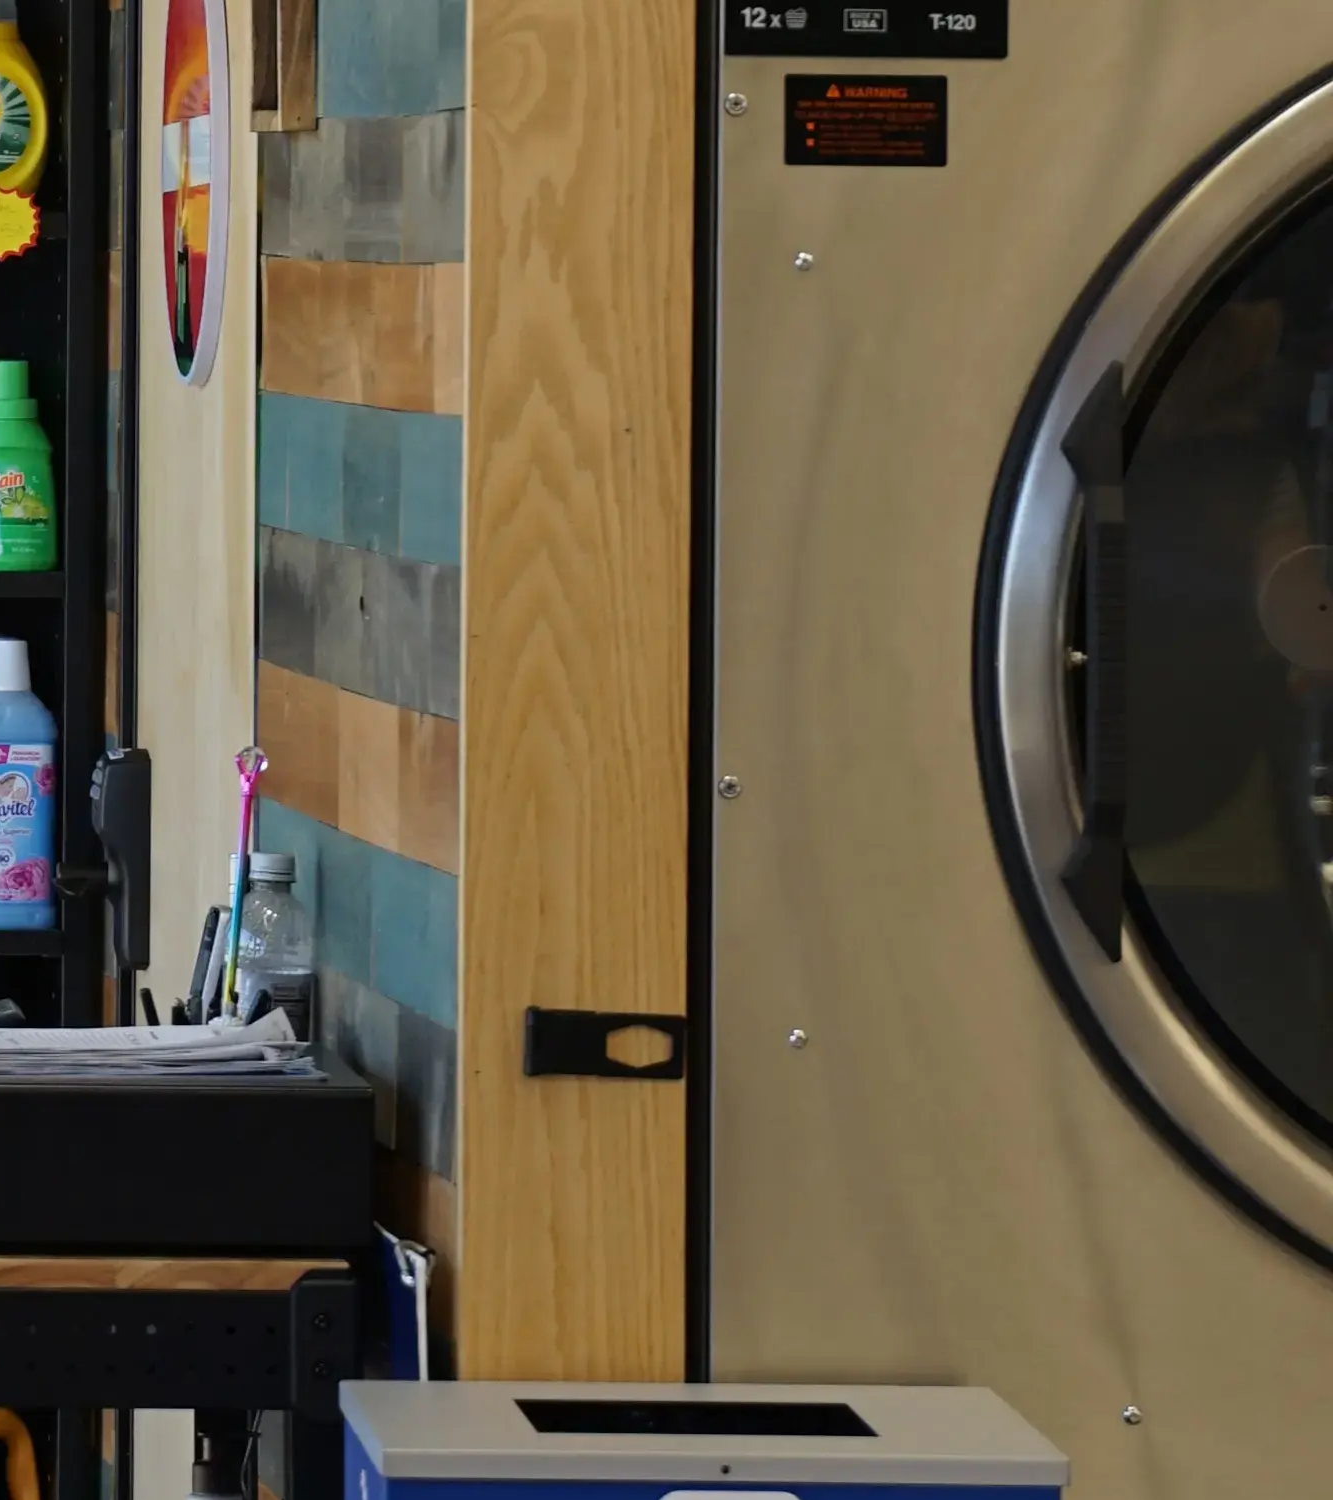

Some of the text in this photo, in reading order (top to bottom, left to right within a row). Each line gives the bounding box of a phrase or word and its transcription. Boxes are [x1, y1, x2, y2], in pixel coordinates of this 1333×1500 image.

[741, 7, 767, 27] 12
[852, 18, 878, 28] USA
[930, 13, 975, 30] T-120
[844, 87, 907, 97] WARNING
